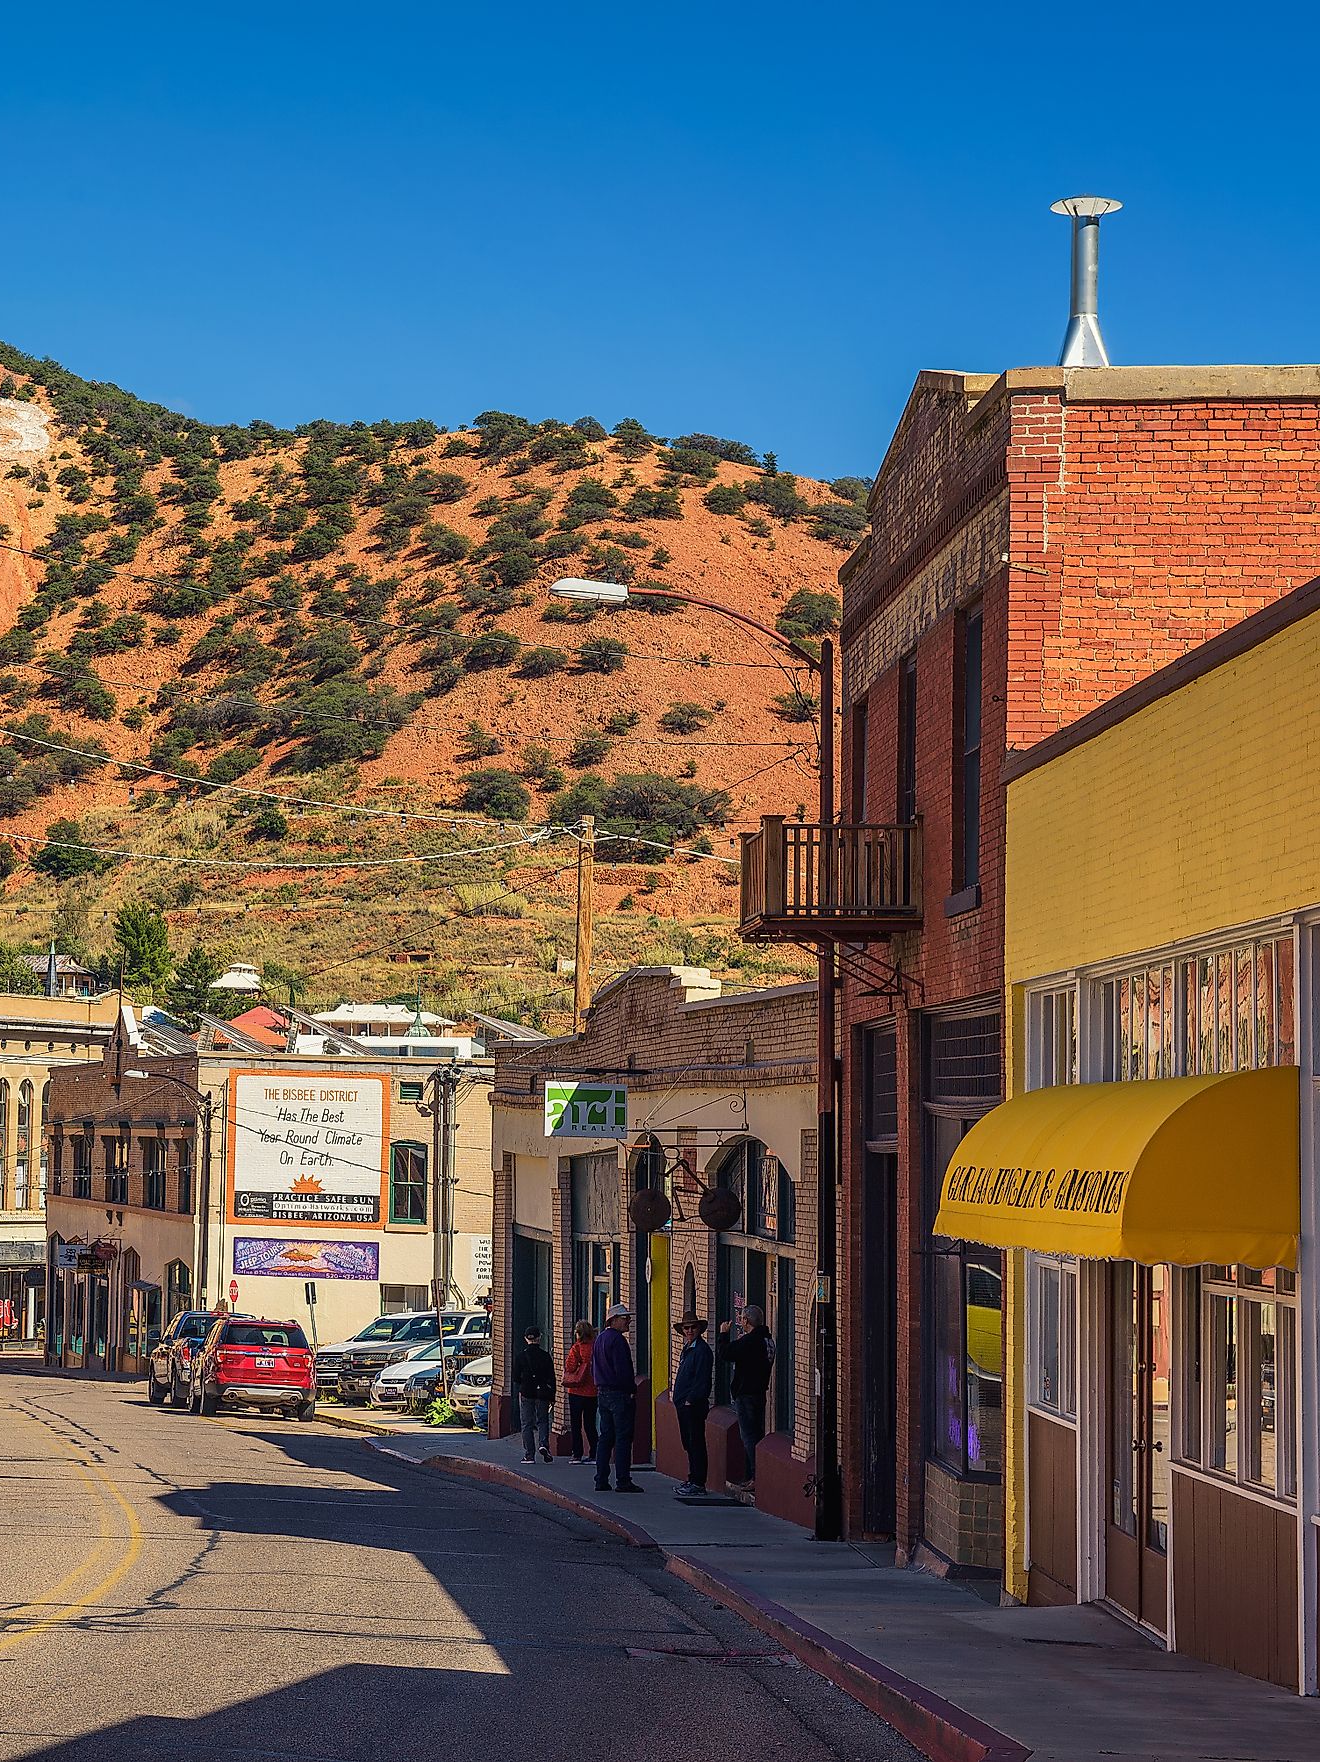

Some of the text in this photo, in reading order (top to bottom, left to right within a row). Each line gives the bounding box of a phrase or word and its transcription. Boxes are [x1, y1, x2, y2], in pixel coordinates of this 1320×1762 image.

[264, 1088, 359, 1102] THE BISBEE DISTRICT
[277, 1107, 345, 1123] Has The Best
[571, 1124, 626, 1132] REALTY
[259, 1129, 363, 1146] Year Round Climate
[280, 1150, 334, 1167] On Earth.
[1039, 1168, 1056, 1209] &
[272, 1193, 320, 1202] PRACTICE
[325, 1195, 347, 1203] SAFE
[353, 1196, 374, 1204] SUN
[272, 1211, 308, 1220] BISBEE,
[312, 1213, 352, 1222] ARIZONA
[356, 1214, 374, 1222] USA
[240, 1242, 284, 1270] JEEP TOURS
